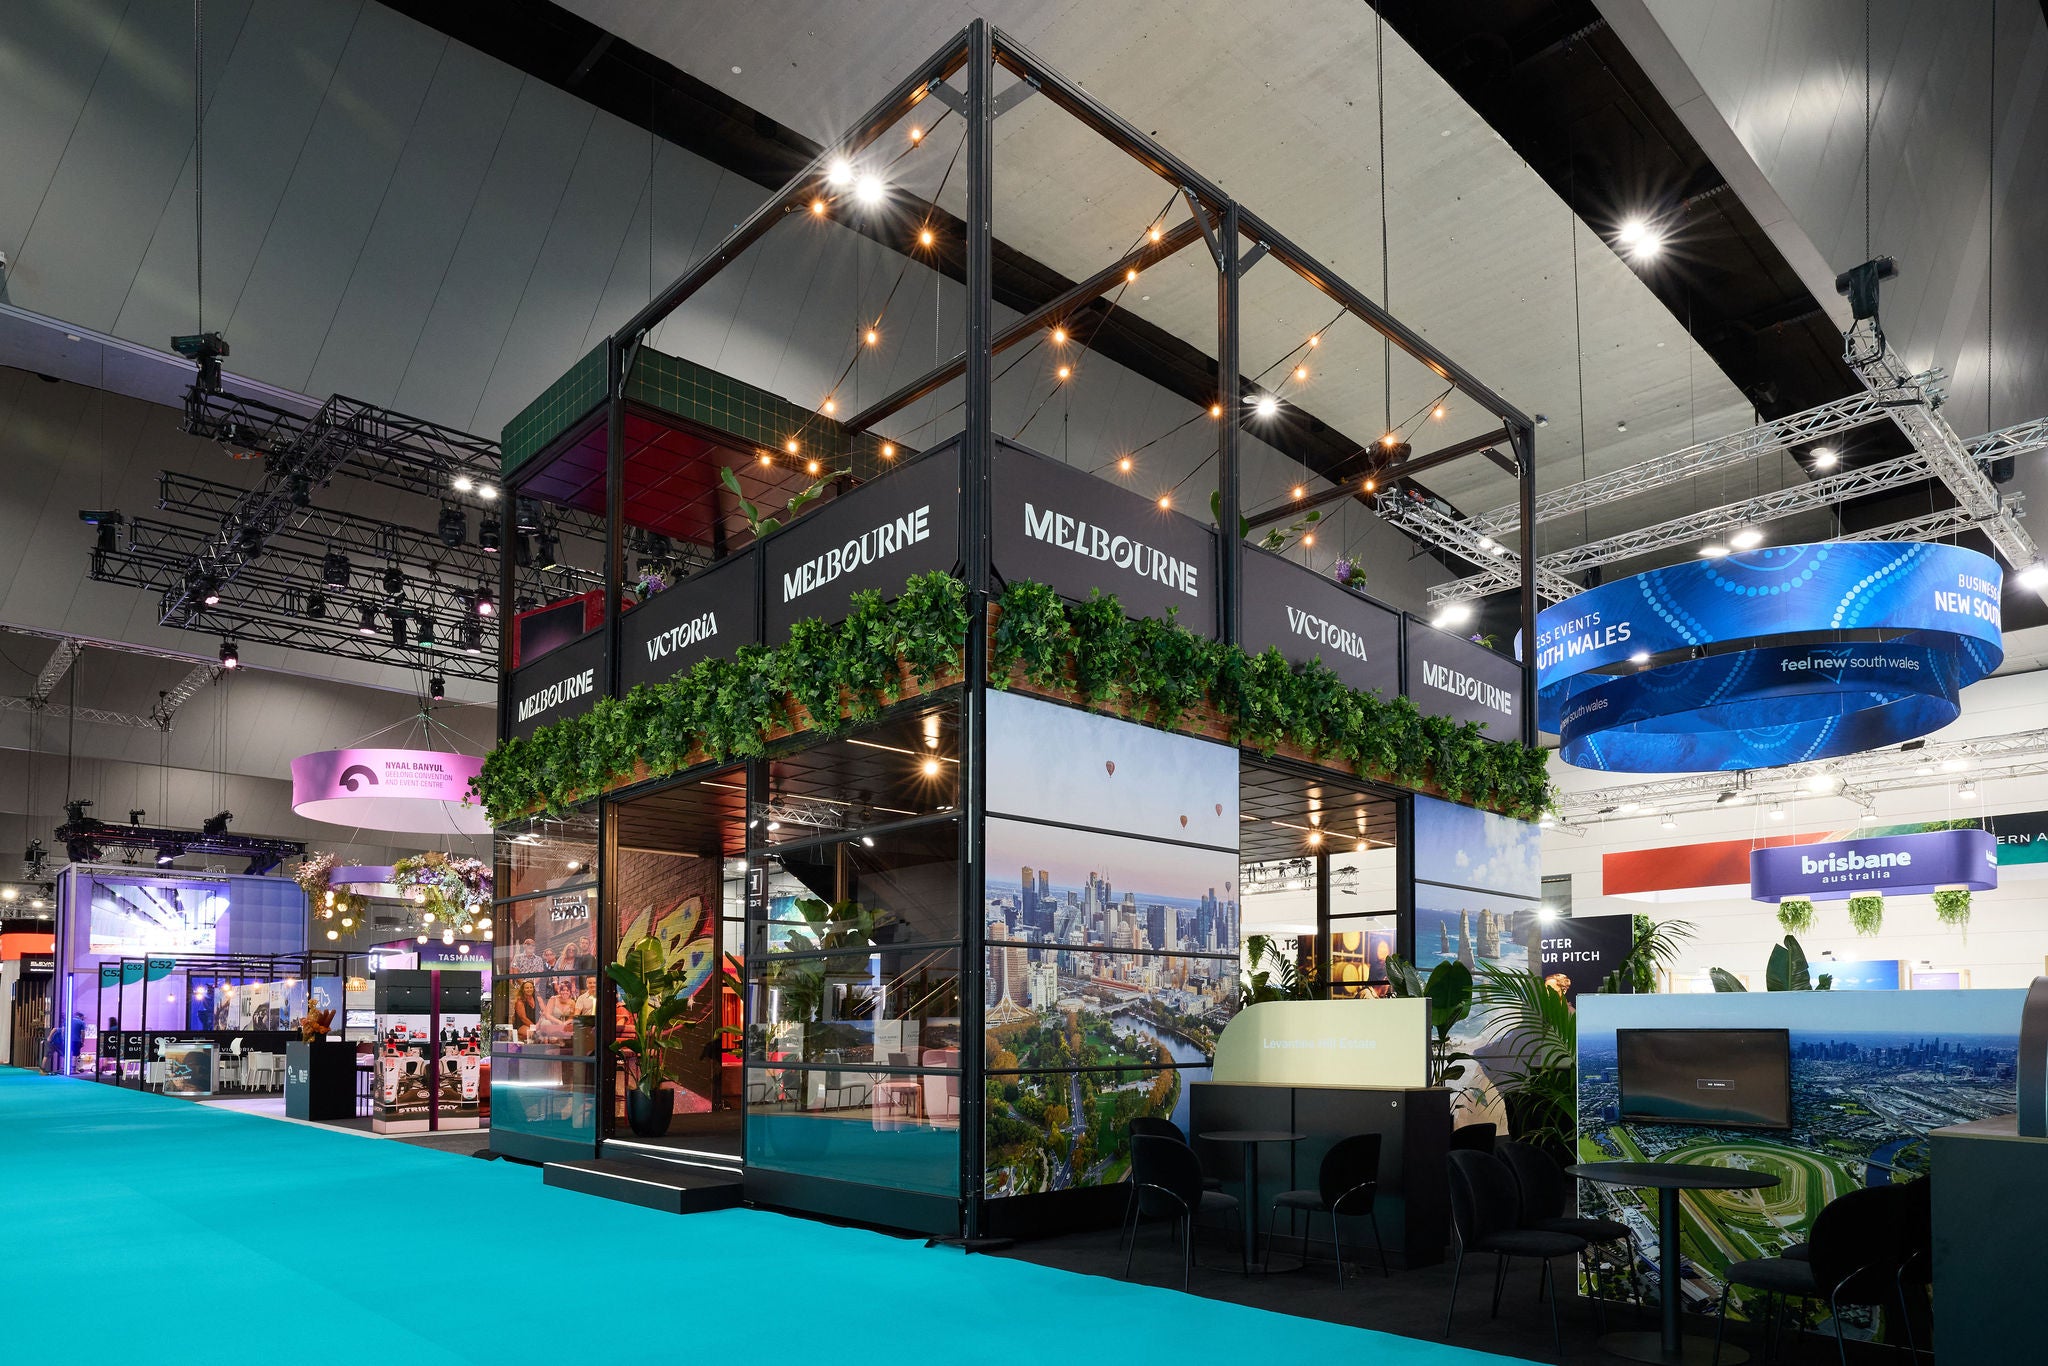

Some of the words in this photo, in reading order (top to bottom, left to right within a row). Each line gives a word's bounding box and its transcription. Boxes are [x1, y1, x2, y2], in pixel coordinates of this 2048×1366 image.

[784, 505, 931, 603] MELBOURNE
[1024, 502, 1199, 597] MELBOURNE
[1958, 573, 1997, 601] BUSINESS
[1934, 590, 1970, 615] NEW
[1554, 611, 1601, 641] EVENTS
[1567, 621, 1631, 658] WALES
[1781, 656, 1811, 671] feel
[1814, 658, 1847, 669] new
[1850, 655, 1887, 668] south
[1888, 656, 1920, 671] wales
[518, 668, 594, 722] MELBOURNE
[1423, 660, 1512, 715] MELBOURNE
[1569, 705, 1586, 722] south
[1585, 698, 1609, 713] wales
[385, 771, 414, 779] GEELONG
[414, 772, 453, 782] CONVENTION
[386, 761, 411, 771] NYAAL
[413, 763, 445, 772] BANYUL
[399, 779, 419, 788] EVENT
[420, 780, 444, 789] CENTRE
[1997, 833, 2030, 845] ERN
[1802, 850, 1911, 875] brisbane
[1822, 870, 1891, 884] australia
[1540, 938, 1572, 950] CTER
[149, 960, 173, 970] C52
[438, 953, 485, 963] TASMANIA
[1562, 950, 1600, 962] PITCH
